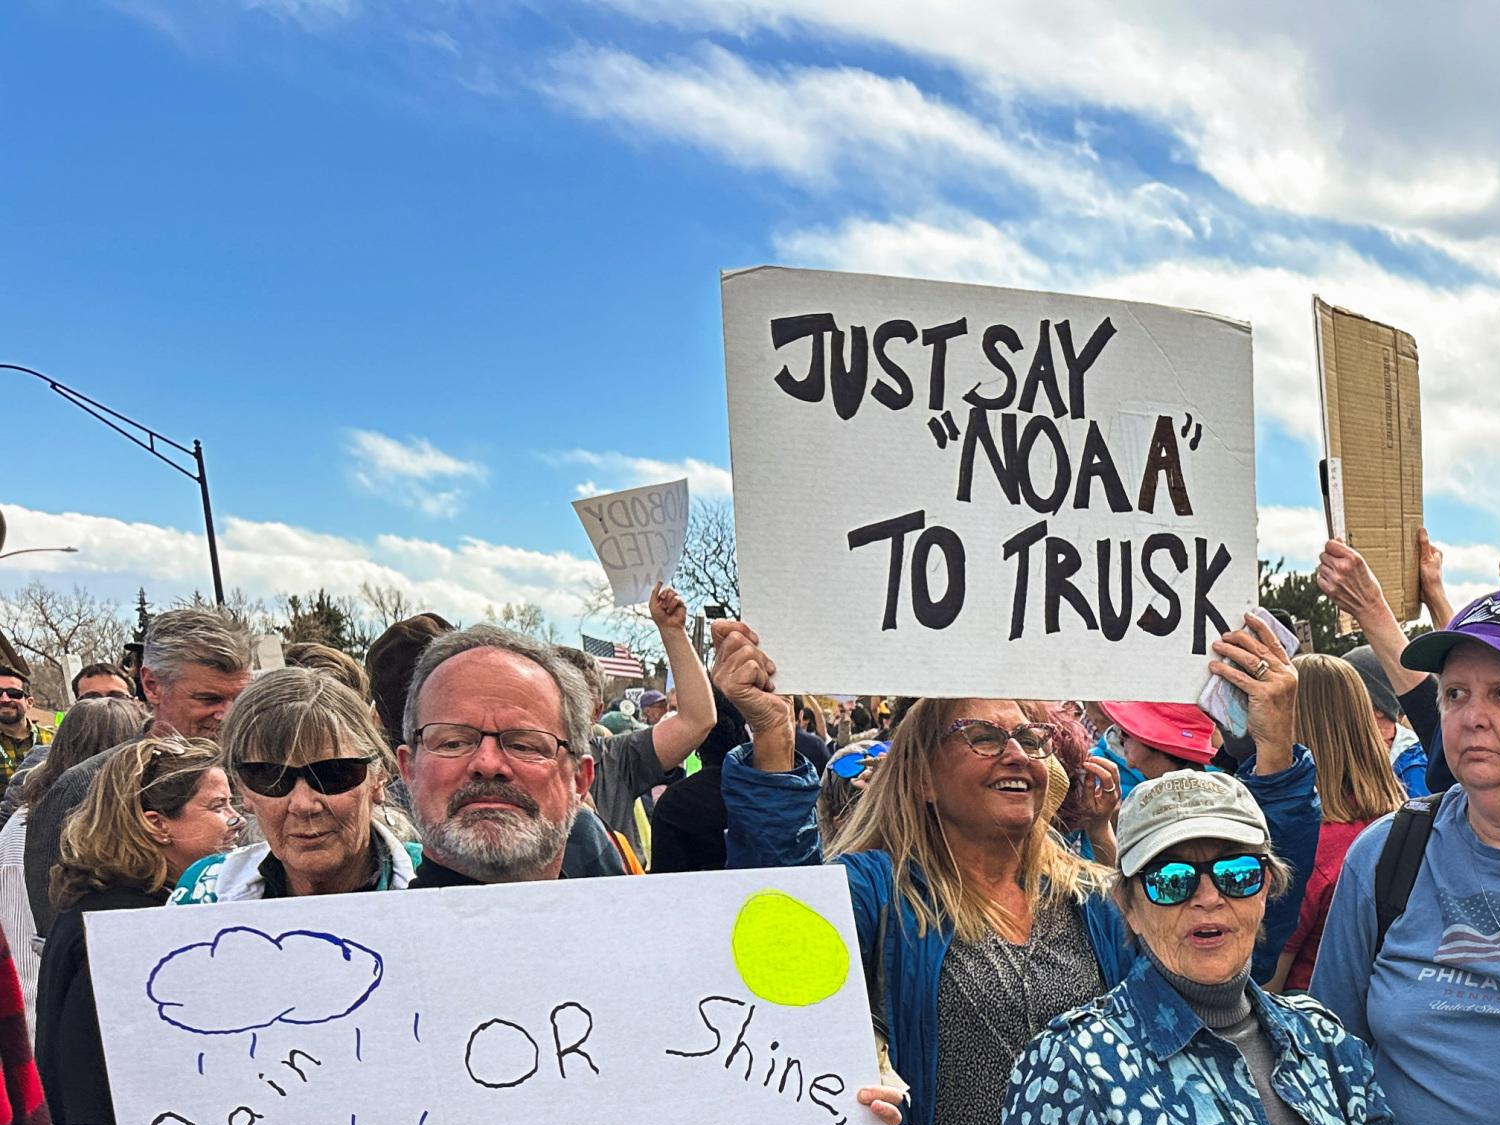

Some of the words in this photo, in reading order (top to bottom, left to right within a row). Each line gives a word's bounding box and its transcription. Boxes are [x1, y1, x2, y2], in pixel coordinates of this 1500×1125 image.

[770, 312, 968, 421] JUST
[962, 316, 1117, 420] SAY
[927, 406, 1202, 516] "NOAA"
[847, 510, 966, 631] TO
[1002, 520, 1232, 655] TRUSK
[1164, 778, 1228, 795] ORLEANS
[465, 1001, 600, 1089] OR
